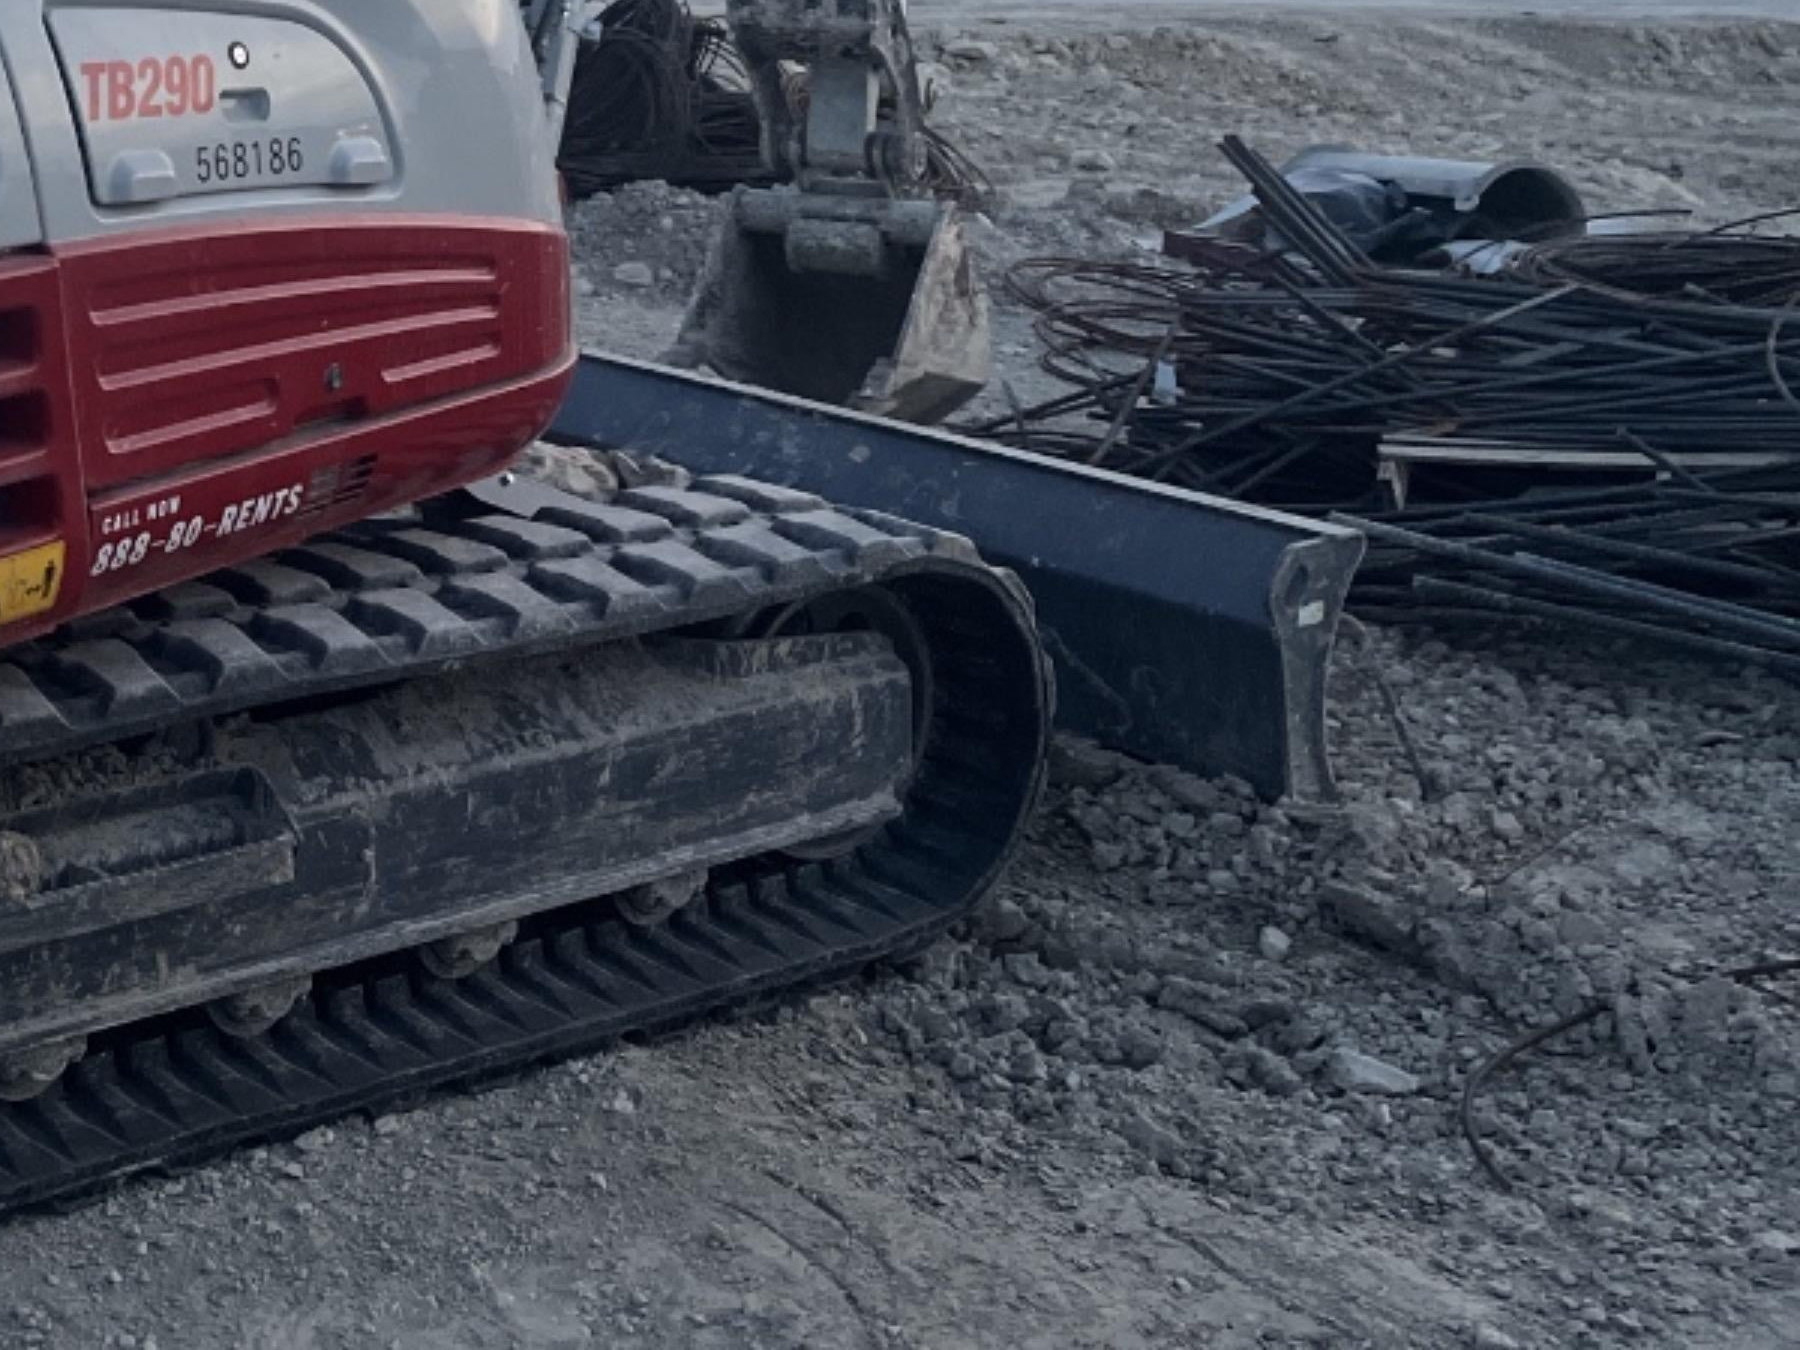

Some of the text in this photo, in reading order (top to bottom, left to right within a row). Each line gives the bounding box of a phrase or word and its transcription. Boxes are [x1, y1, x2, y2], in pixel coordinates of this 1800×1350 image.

[80, 54, 214, 121] TB290
[196, 137, 302, 183] 568186
[90, 483, 304, 577] 888-80-RENTS
[102, 495, 181, 535] CALL NOW
